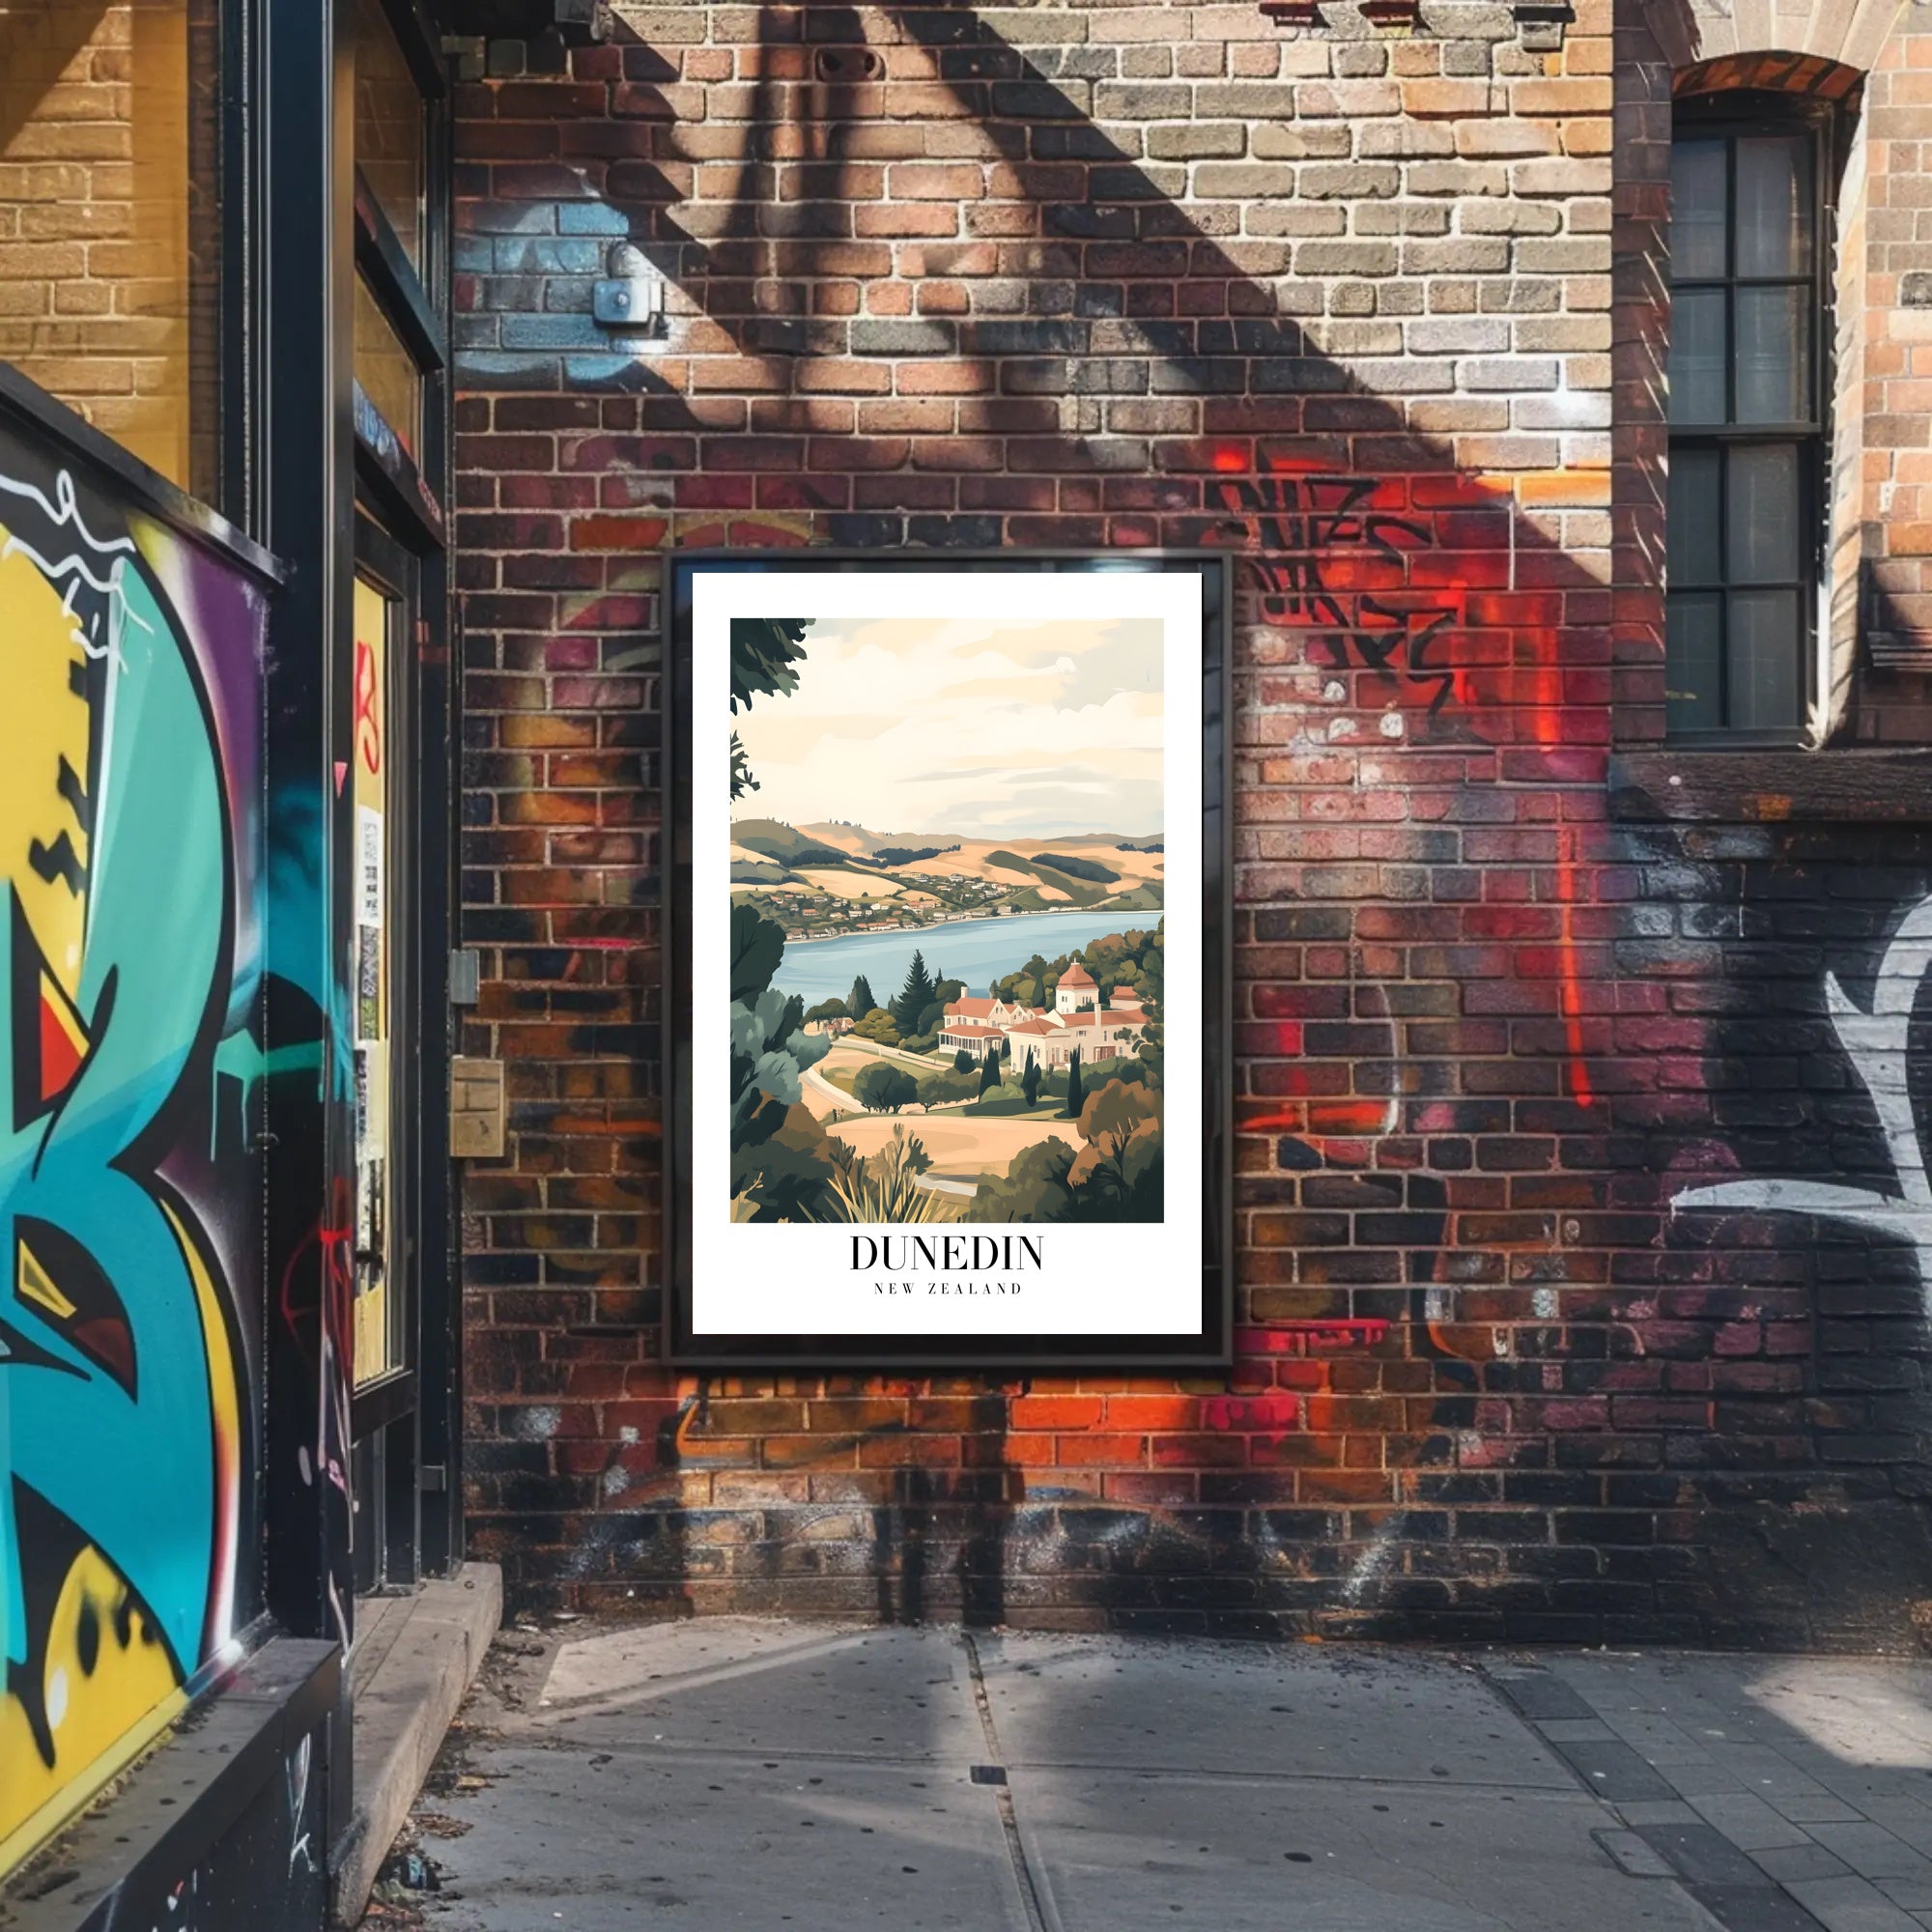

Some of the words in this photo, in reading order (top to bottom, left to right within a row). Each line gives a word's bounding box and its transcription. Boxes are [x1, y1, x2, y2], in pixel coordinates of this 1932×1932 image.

[850, 1236, 1044, 1270] DUNEDIN
[874, 1283, 914, 1294] NEW
[928, 1283, 1021, 1294] ZEALAND
